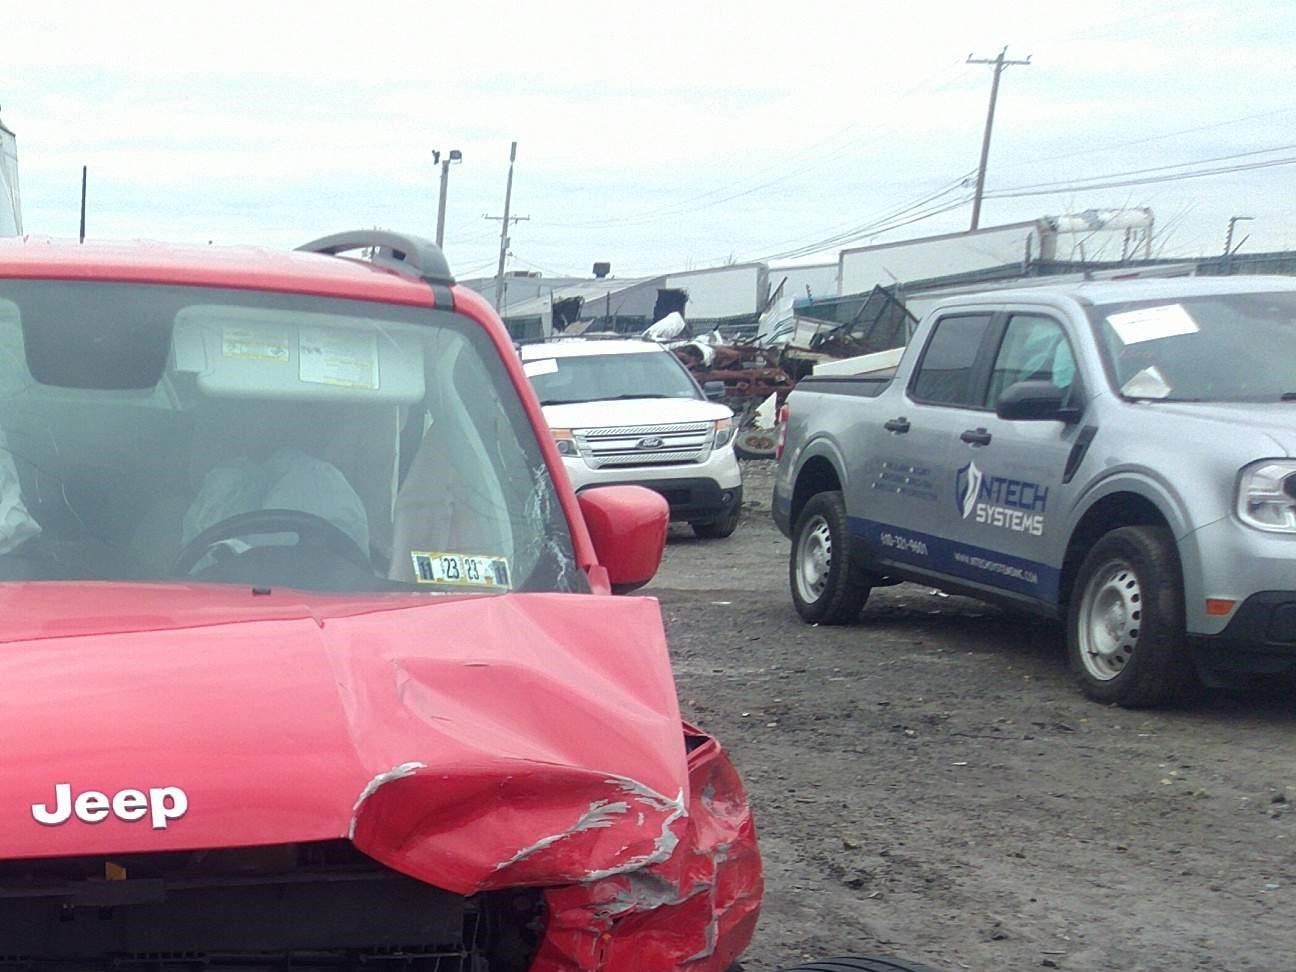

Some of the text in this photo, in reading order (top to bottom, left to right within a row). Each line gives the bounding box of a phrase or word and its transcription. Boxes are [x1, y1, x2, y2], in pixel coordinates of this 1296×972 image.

[976, 503, 1044, 536] SYSTEMS
[444, 558, 460, 579] 23
[31, 783, 189, 829] Jeep
